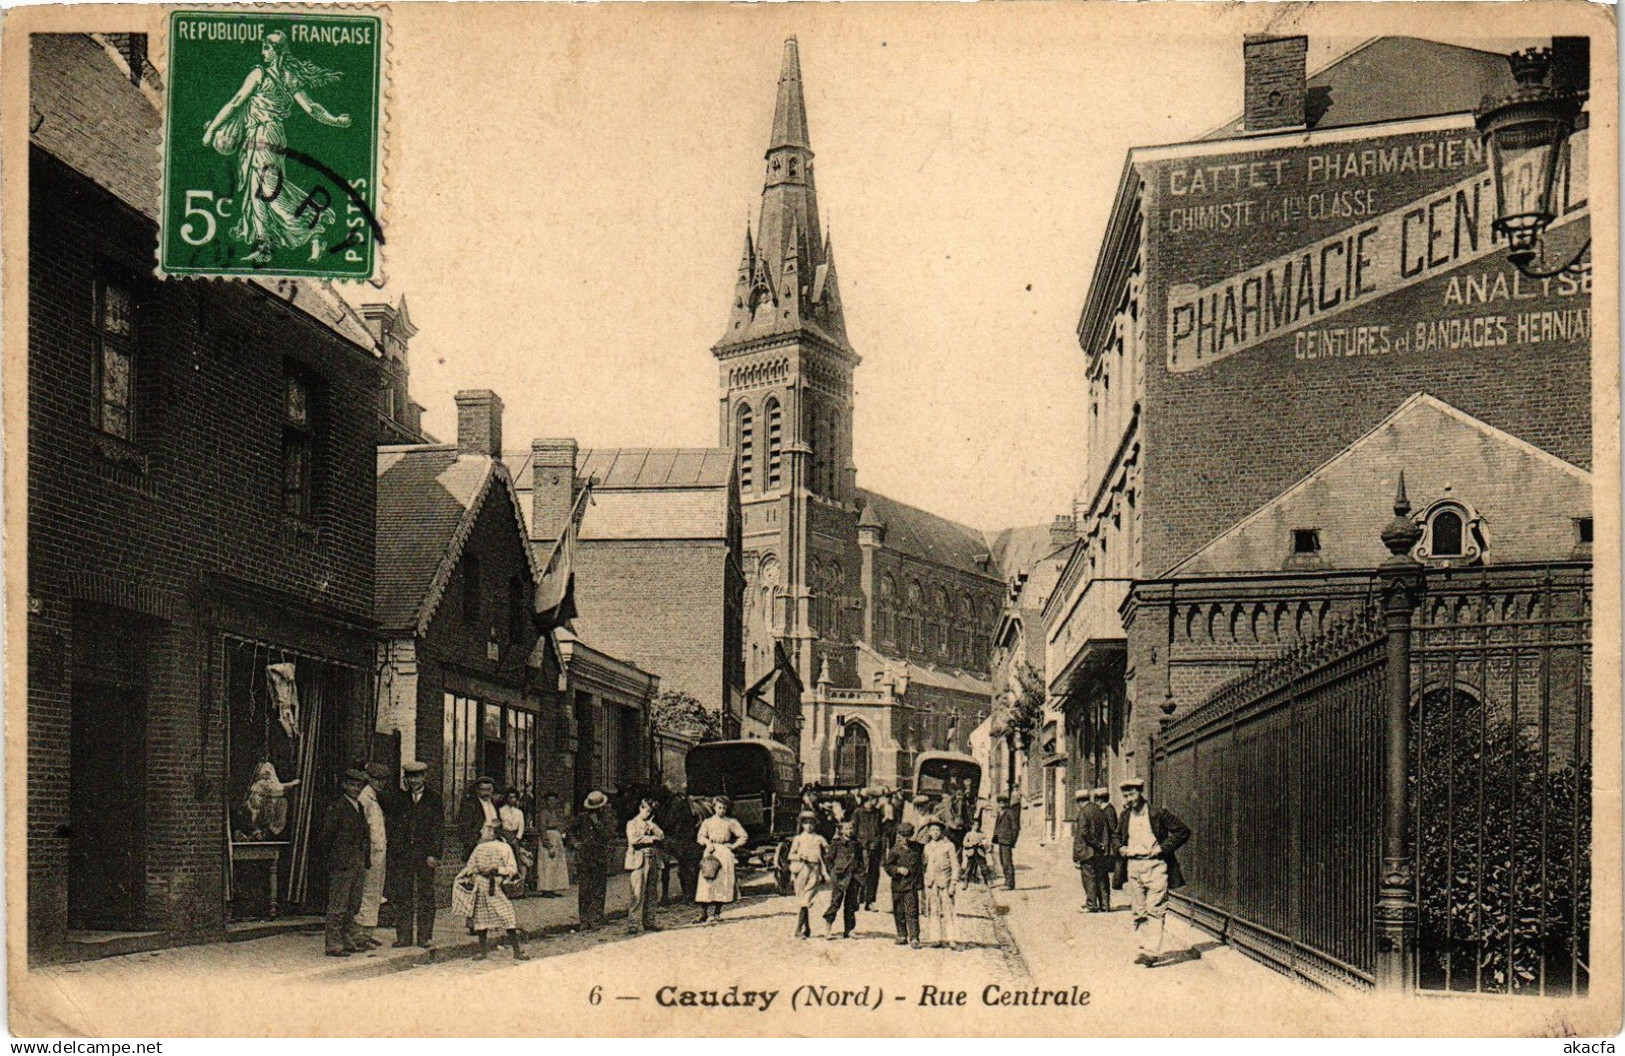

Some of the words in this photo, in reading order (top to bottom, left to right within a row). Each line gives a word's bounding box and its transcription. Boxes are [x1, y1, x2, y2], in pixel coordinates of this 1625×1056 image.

[291, 25, 372, 46] FRANÇAISE
[1169, 159, 1290, 196] CATTET
[1307, 136, 1484, 182] PHARMACIEN
[1169, 200, 1253, 233] CHIMISTE
[1307, 188, 1379, 221] CLASSE
[1172, 226, 1379, 365] PHARMACIE
[1294, 326, 1391, 360] CEINTURES
[1414, 315, 1508, 351] BANDAGES
